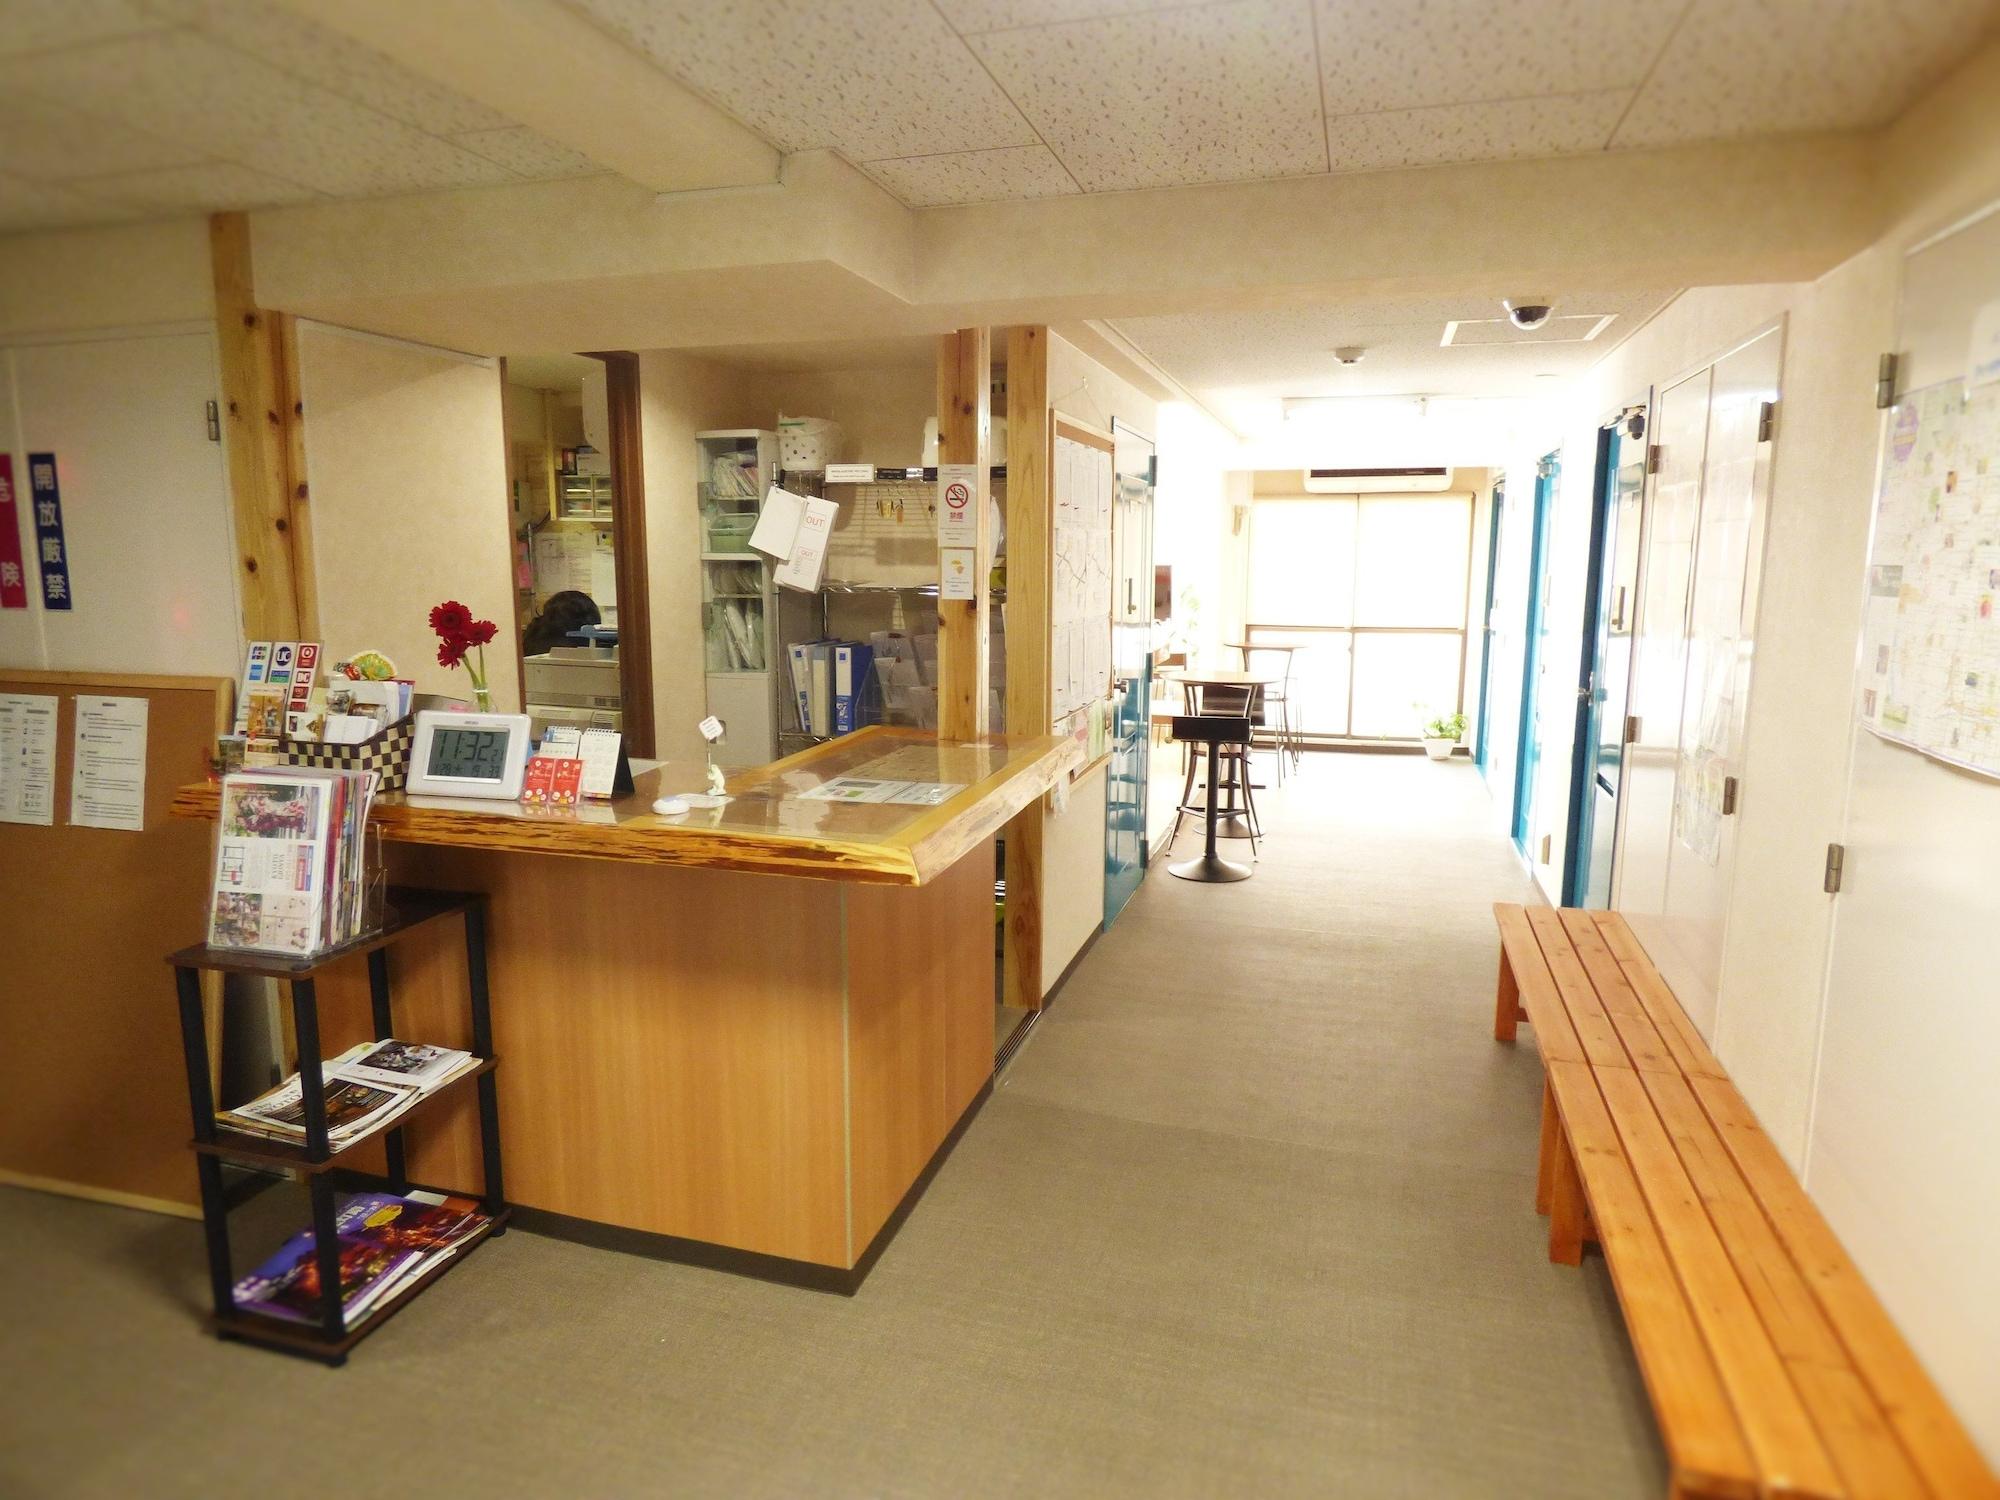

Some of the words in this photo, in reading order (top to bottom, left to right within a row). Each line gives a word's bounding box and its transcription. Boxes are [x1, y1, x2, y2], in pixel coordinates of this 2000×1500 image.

[806, 516, 825, 528] OUT
[33, 463, 66, 600] 開放厳禁
[800, 549, 814, 558] OUT
[277, 650, 292, 662] UC
[297, 672, 310, 683] DC
[439, 731, 495, 761] 11:32
